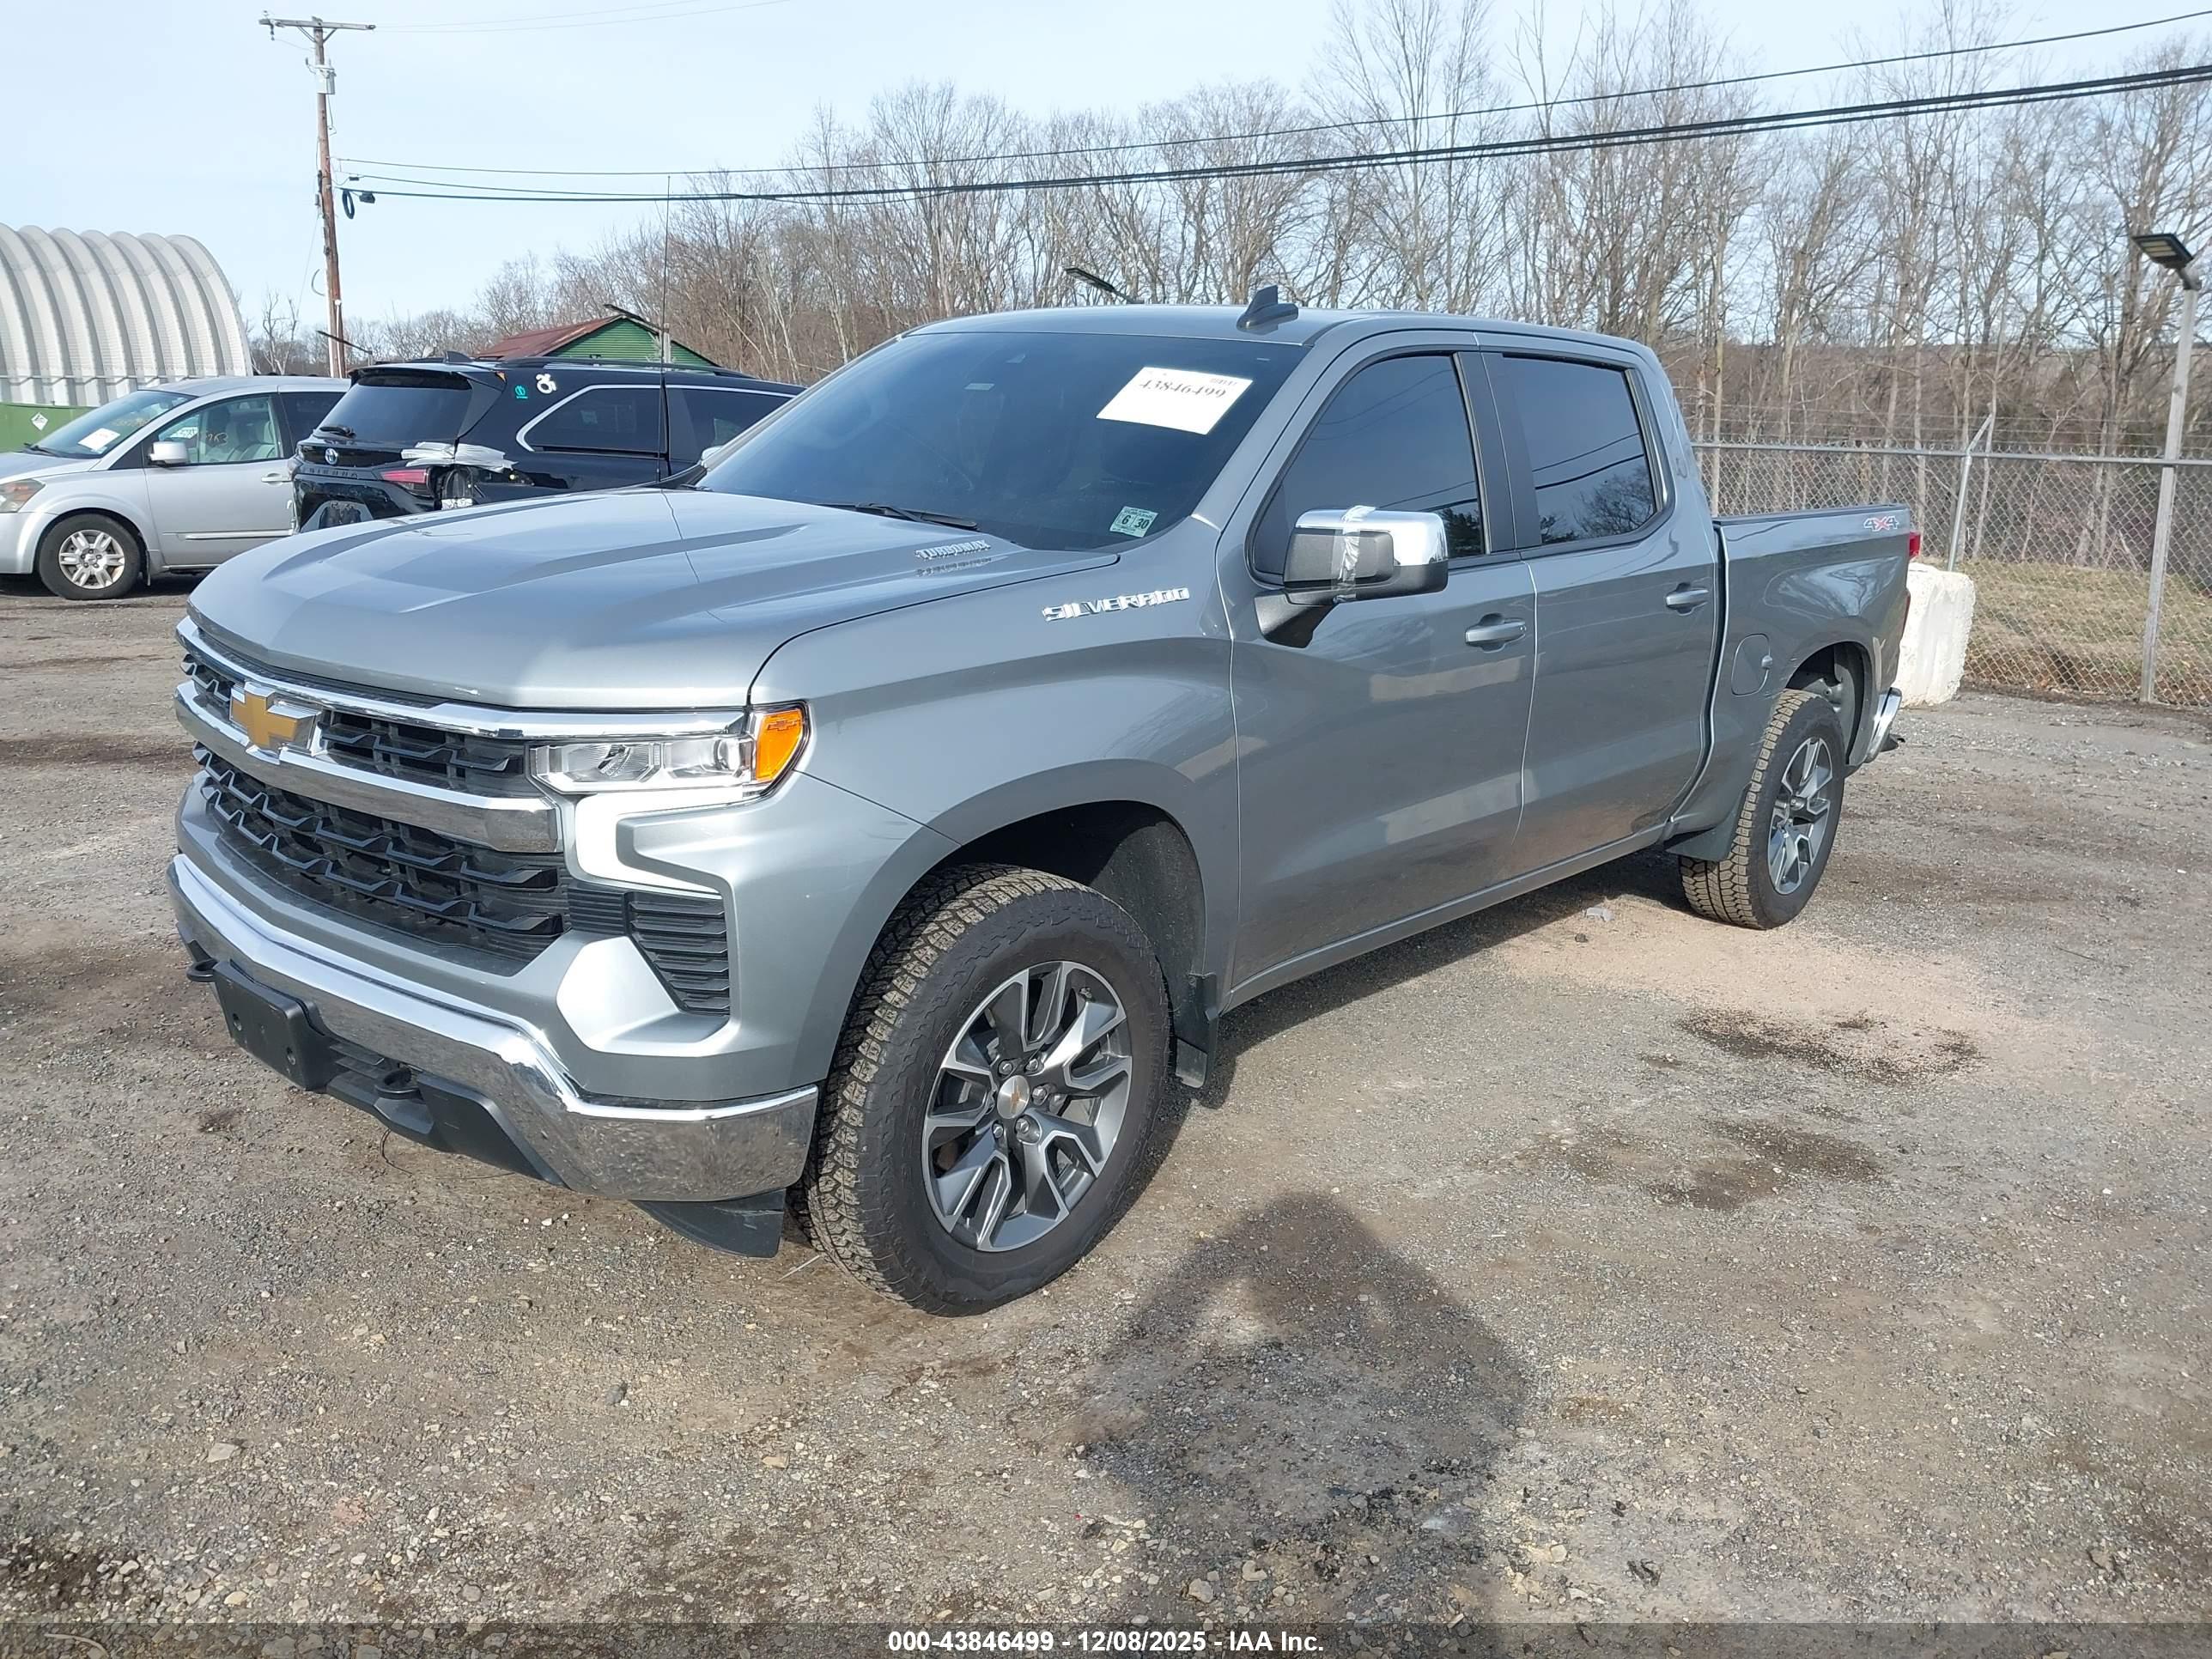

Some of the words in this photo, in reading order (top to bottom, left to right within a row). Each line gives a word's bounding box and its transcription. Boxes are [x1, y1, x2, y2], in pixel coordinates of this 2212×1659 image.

[1139, 380, 1226, 398] 43846499
[1121, 514, 1132, 525] 6
[1134, 518, 1150, 530] 30
[1042, 587, 1190, 622] SILVERADO
